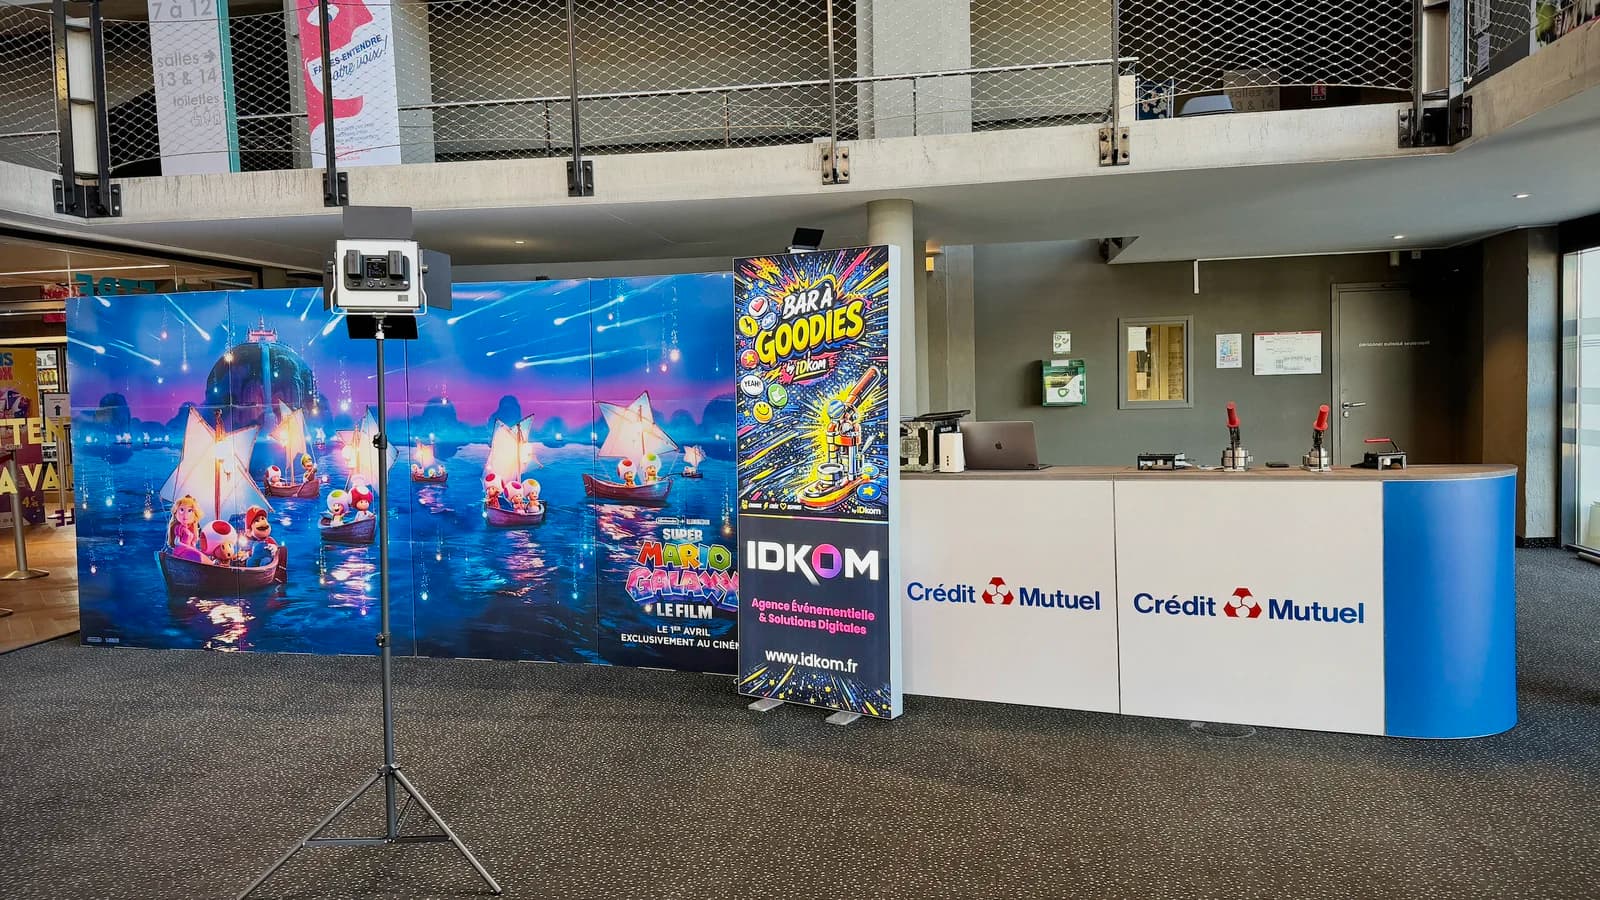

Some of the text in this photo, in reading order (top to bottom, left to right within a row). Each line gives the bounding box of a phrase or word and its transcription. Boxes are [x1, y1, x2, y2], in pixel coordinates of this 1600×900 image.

[152, 0, 212, 20] 7 à 12
[157, 52, 200, 68] salles
[159, 69, 217, 87] 13 & 14
[332, 62, 355, 81] otre
[173, 93, 220, 108] toilettes
[782, 283, 833, 319] BAR À
[755, 301, 865, 366] GOODIES
[662, 528, 703, 541] SUPER
[637, 540, 732, 571] MARIO
[746, 540, 880, 586] IDKOM
[906, 581, 1102, 611] Crédit Mutuel
[656, 602, 713, 620] LE FILM
[751, 597, 876, 622] Agence Événementielle
[1133, 592, 1366, 625] Crédit Mutuel
[657, 625, 669, 634] LE
[683, 627, 711, 637] AVRIL
[758, 613, 867, 636] & Solutions Digitales
[621, 633, 695, 647] EXCLUSIVEMENT
[696, 639, 711, 648] AU
[765, 650, 859, 674] www.idkom.fr
